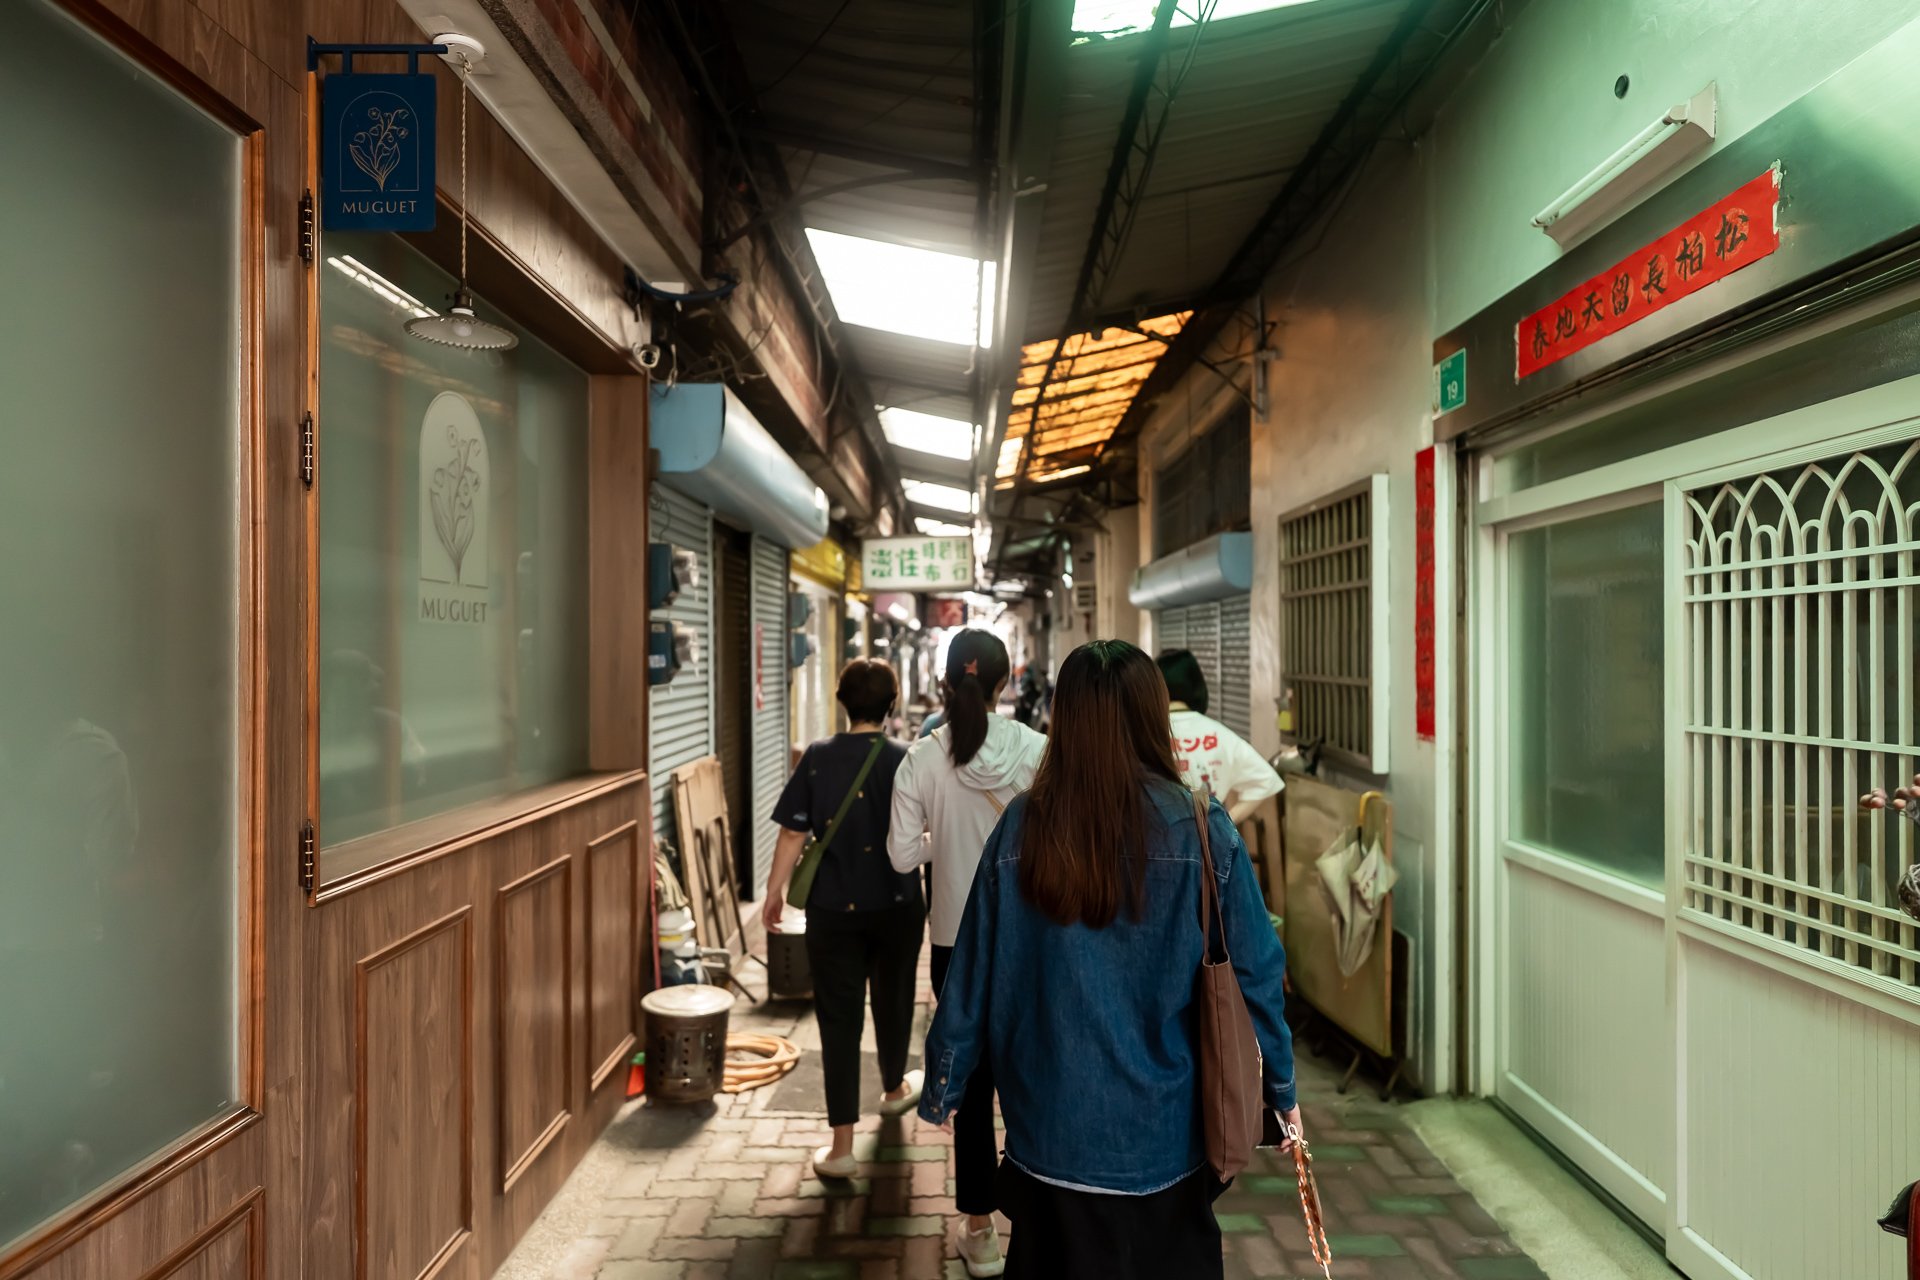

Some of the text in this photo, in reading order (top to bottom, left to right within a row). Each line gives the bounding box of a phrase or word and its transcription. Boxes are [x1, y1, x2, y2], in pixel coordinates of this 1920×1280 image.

[342, 200, 417, 214] MUGUET
[1446, 380, 1459, 401] 19
[421, 597, 488, 623] MUGUET
